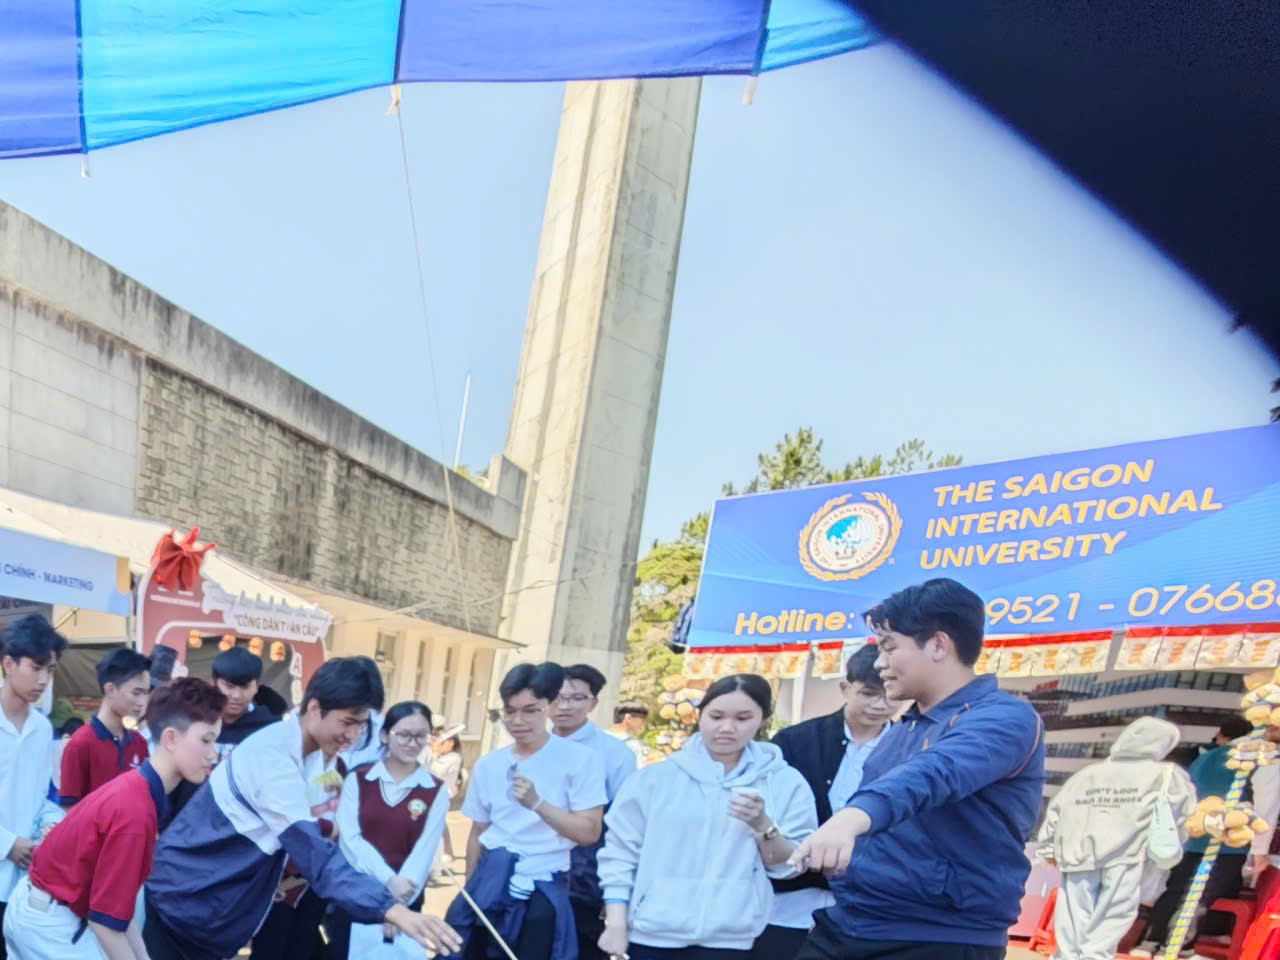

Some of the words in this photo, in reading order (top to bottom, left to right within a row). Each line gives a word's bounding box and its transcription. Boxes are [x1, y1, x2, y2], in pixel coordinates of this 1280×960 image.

[933, 479, 996, 508] THE
[1002, 459, 1154, 500] SAIGON
[926, 487, 1224, 539] INTERNATIONAL
[919, 530, 1127, 571] UNIVERSITY
[43, 570, 94, 592] MARKETING
[734, 607, 856, 637] Hotline:
[985, 591, 1081, 625] 9521
[1128, 579, 1280, 617] 07668
